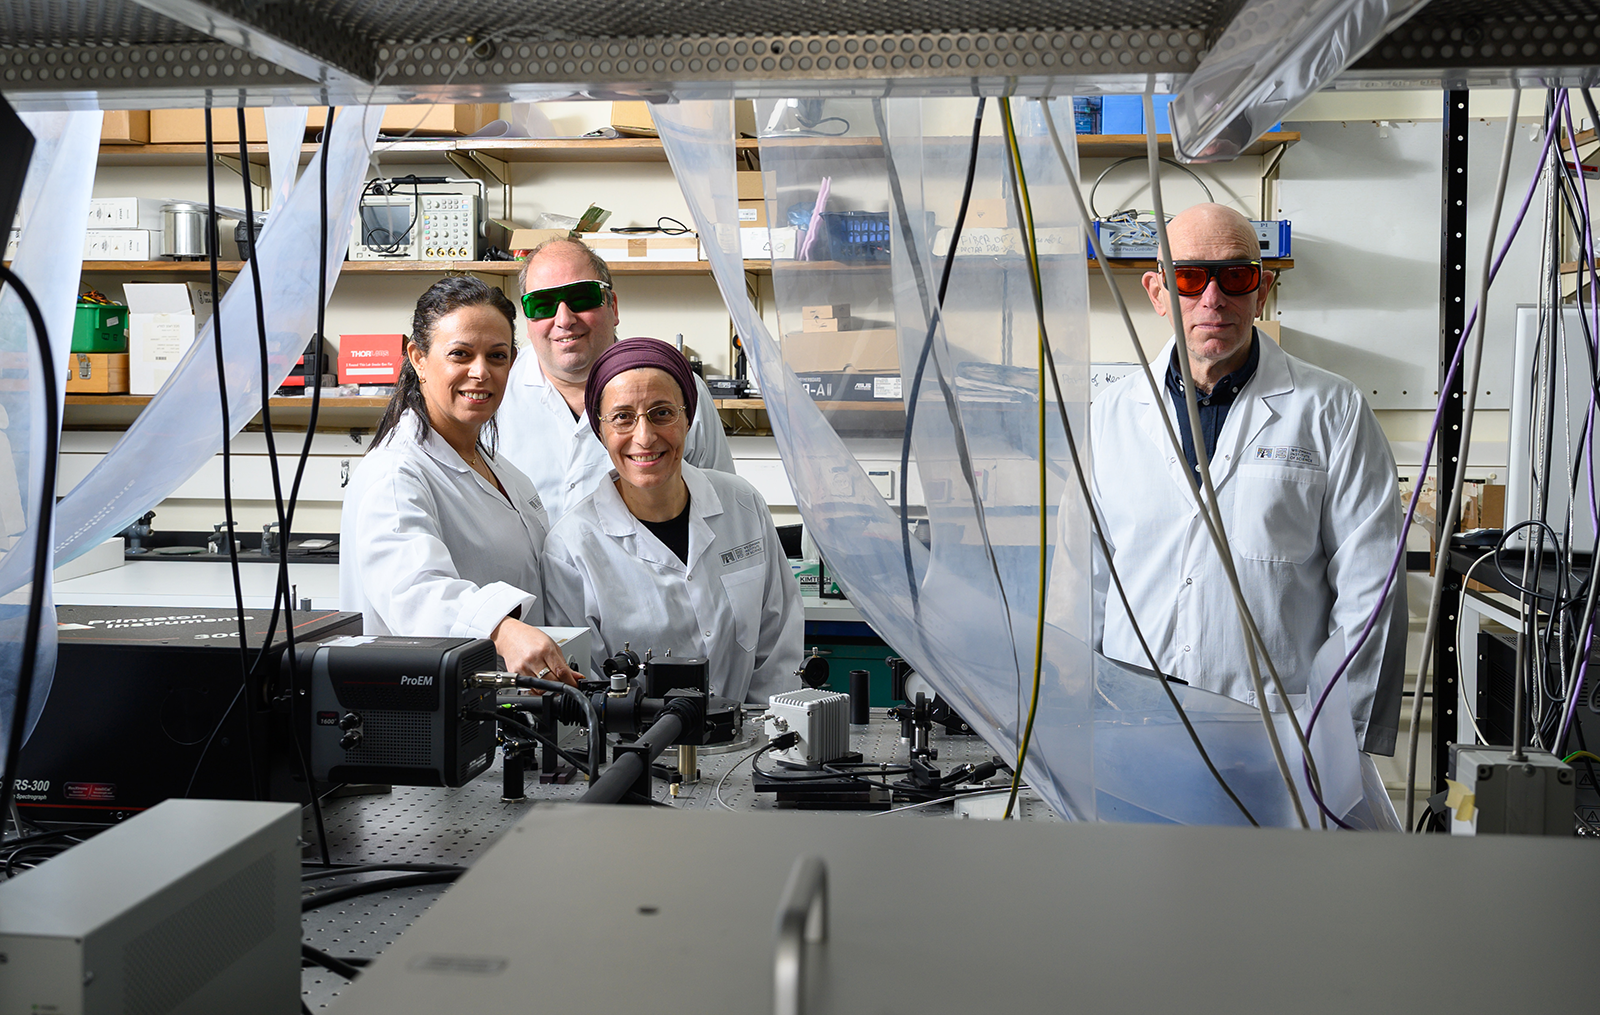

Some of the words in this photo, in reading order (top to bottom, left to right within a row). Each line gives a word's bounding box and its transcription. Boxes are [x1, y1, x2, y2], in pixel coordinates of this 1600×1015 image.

[88, 615, 206, 625] Princeton
[401, 675, 433, 686] ProEM
[13, 779, 50, 791] RS-300
